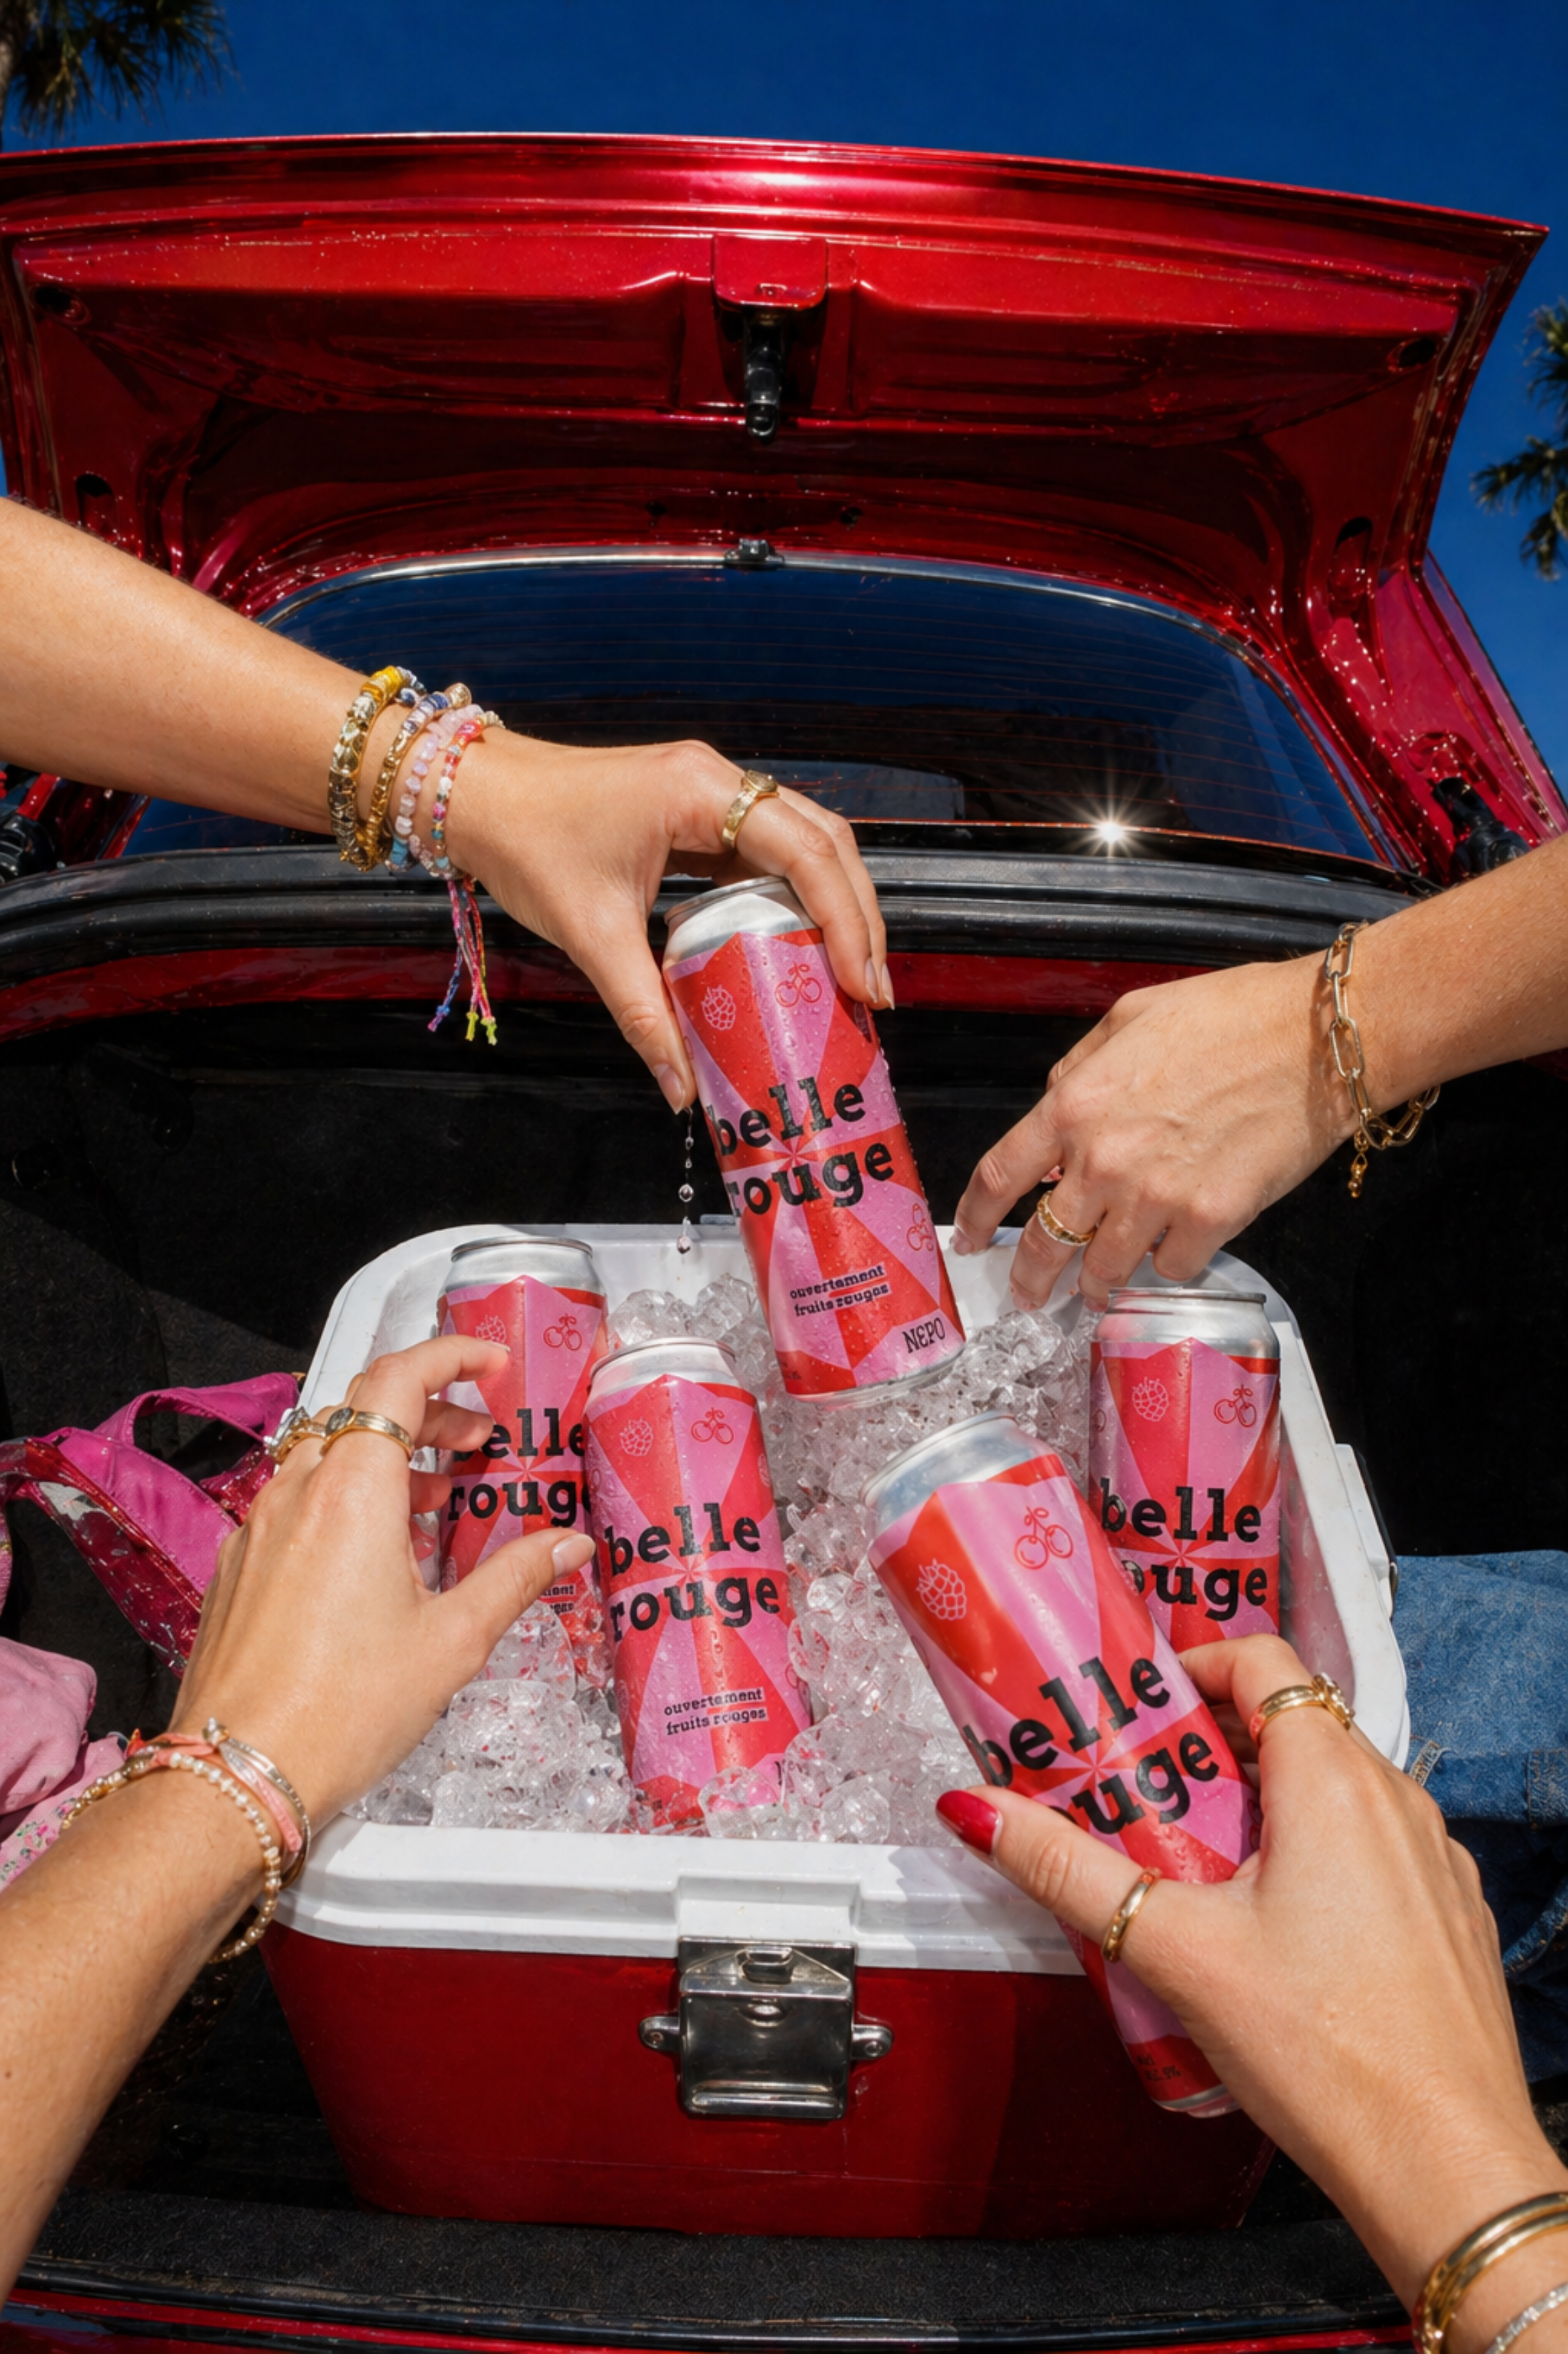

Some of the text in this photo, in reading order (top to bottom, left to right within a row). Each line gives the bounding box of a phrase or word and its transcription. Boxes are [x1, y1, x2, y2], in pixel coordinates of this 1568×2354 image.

[706, 1077, 866, 1156] belle
[726, 1143, 894, 1217] rouge
[794, 1283, 889, 1317] fruits rouges
[902, 1317, 945, 1354] NEPO
[453, 1408, 584, 1462] elle
[605, 1502, 761, 1577] belle
[1101, 1477, 1261, 1543] belle
[610, 1577, 780, 1642] rouge
[663, 1688, 763, 1715] ouvertement
[665, 1708, 767, 1735] fruits rouges
[962, 1656, 1171, 1788] belle
[1047, 1732, 1220, 1835] uge
